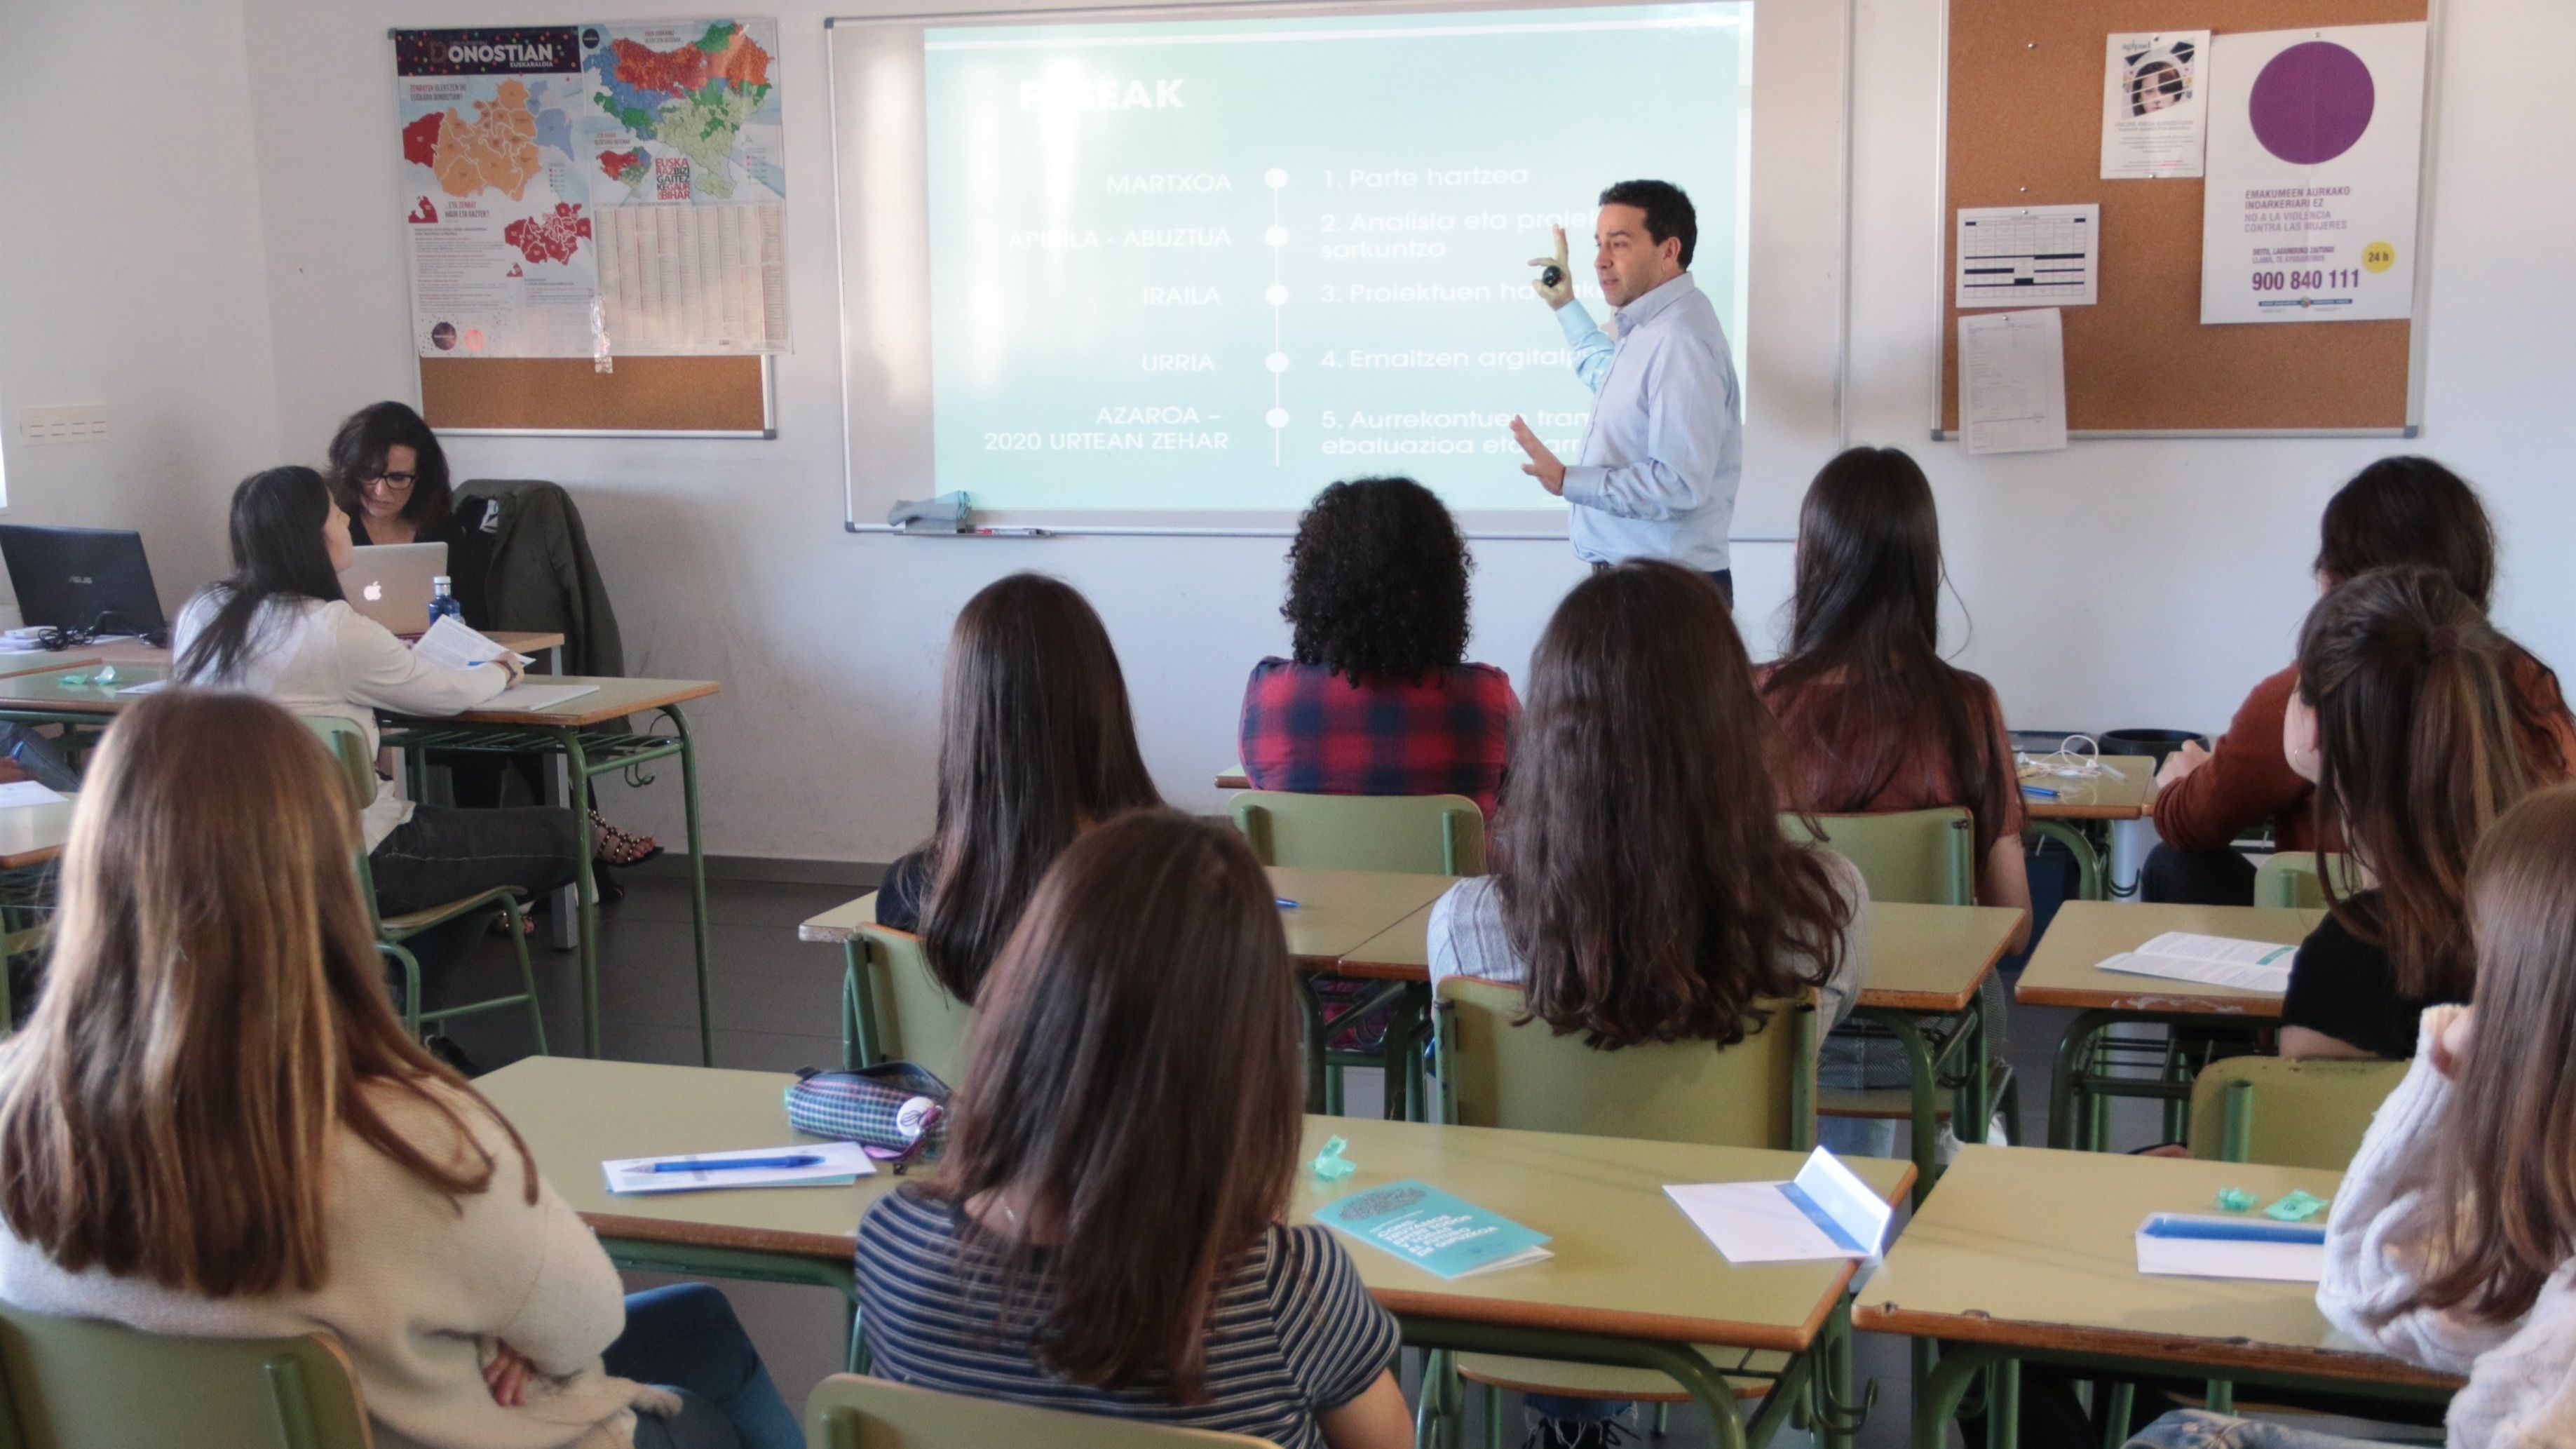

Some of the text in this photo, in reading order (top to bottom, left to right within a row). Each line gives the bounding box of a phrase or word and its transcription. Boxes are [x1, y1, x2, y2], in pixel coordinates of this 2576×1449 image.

[1019, 79, 1186, 111] FSEAK
[656, 158, 690, 168] EUSKA
[657, 175, 691, 184] GAITEZ
[1106, 173, 1233, 193] MARTXOA
[1324, 166, 1528, 188] 1. Parte hartzea
[2245, 186, 2350, 199] EMAKUMEEN AURKAKO
[2245, 198, 2324, 210] INDARKERIARI EZ
[1321, 213, 1342, 232] 2.
[1350, 213, 1456, 231] Analisia
[1464, 211, 1507, 230] eta
[2244, 211, 2331, 222] NO A LA VIOLENCIA
[2244, 221, 2347, 232] CONTRA LAS MUJERES
[1008, 230, 1099, 250] APIRILA
[1123, 229, 1233, 248] ABUZTUA
[1321, 240, 1446, 258] sorkuntza
[2368, 251, 2389, 262] 24 h
[2252, 269, 2359, 291] 900 840 111
[1143, 286, 1222, 305] IRAILA
[1321, 285, 1343, 302] 3.
[1350, 283, 1492, 302] Proiektuen
[1142, 353, 1216, 371] URRIA
[1321, 349, 1343, 368] 4.
[1350, 349, 1470, 368] Emaitzen
[1096, 407, 1200, 424] AZAROA
[1321, 410, 1343, 429] 5.
[984, 431, 1230, 450] 2020 URTEAN ZEHAR
[1321, 436, 1474, 454] ebaluazioa
